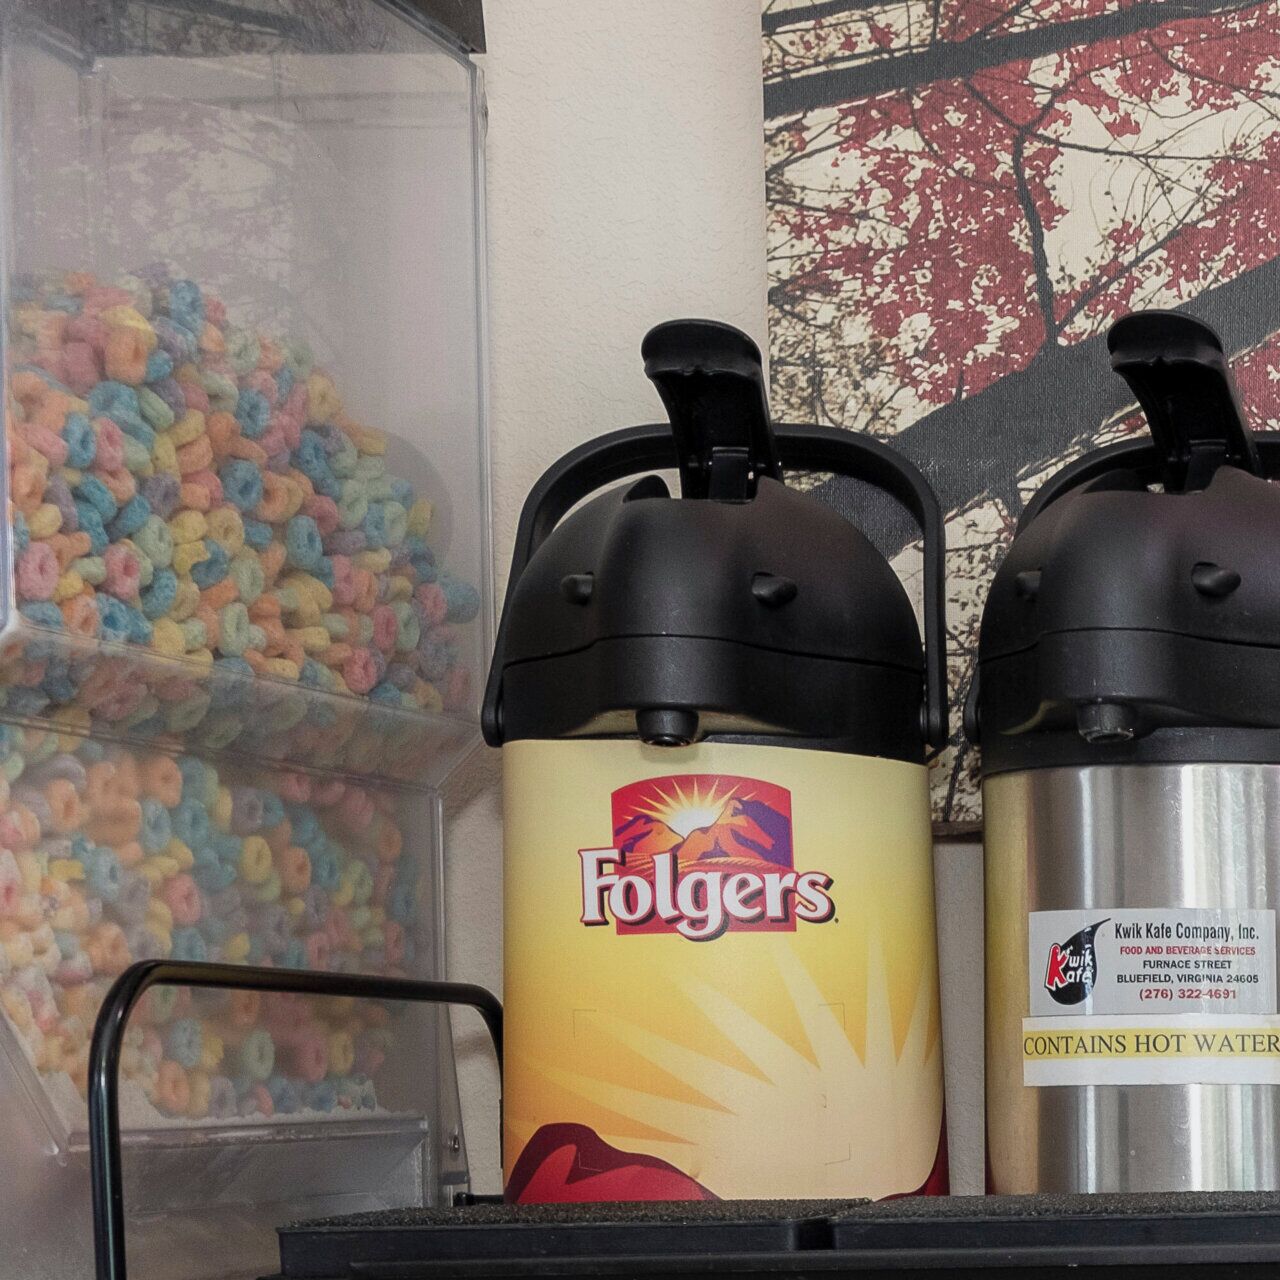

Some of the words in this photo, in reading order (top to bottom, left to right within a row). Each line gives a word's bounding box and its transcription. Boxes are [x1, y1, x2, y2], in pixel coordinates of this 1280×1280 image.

[577, 847, 835, 942] Folgers
[1115, 922, 1142, 939] Kwik
[1146, 922, 1172, 939] Kafe
[1176, 922, 1234, 942] Company,
[1238, 923, 1259, 940] Inc.
[1120, 946, 1143, 955] FOOD
[1145, 946, 1163, 955] AND
[1166, 946, 1212, 955] BEVERAGE
[1214, 946, 1256, 956] SERVICES
[1143, 960, 1191, 969] FURNACE
[1194, 960, 1232, 969] STREET
[1117, 974, 1174, 984] BLUEFIELD,
[1176, 974, 1223, 983] VIRGINIA
[1226, 974, 1259, 984] 24605
[1139, 988, 1173, 1001] (276)
[1178, 988, 1236, 999] 322-4691
[1023, 1035, 1126, 1056] CONTAINS
[1135, 1034, 1186, 1053] HOT
[1193, 1033, 1280, 1053] WATER
